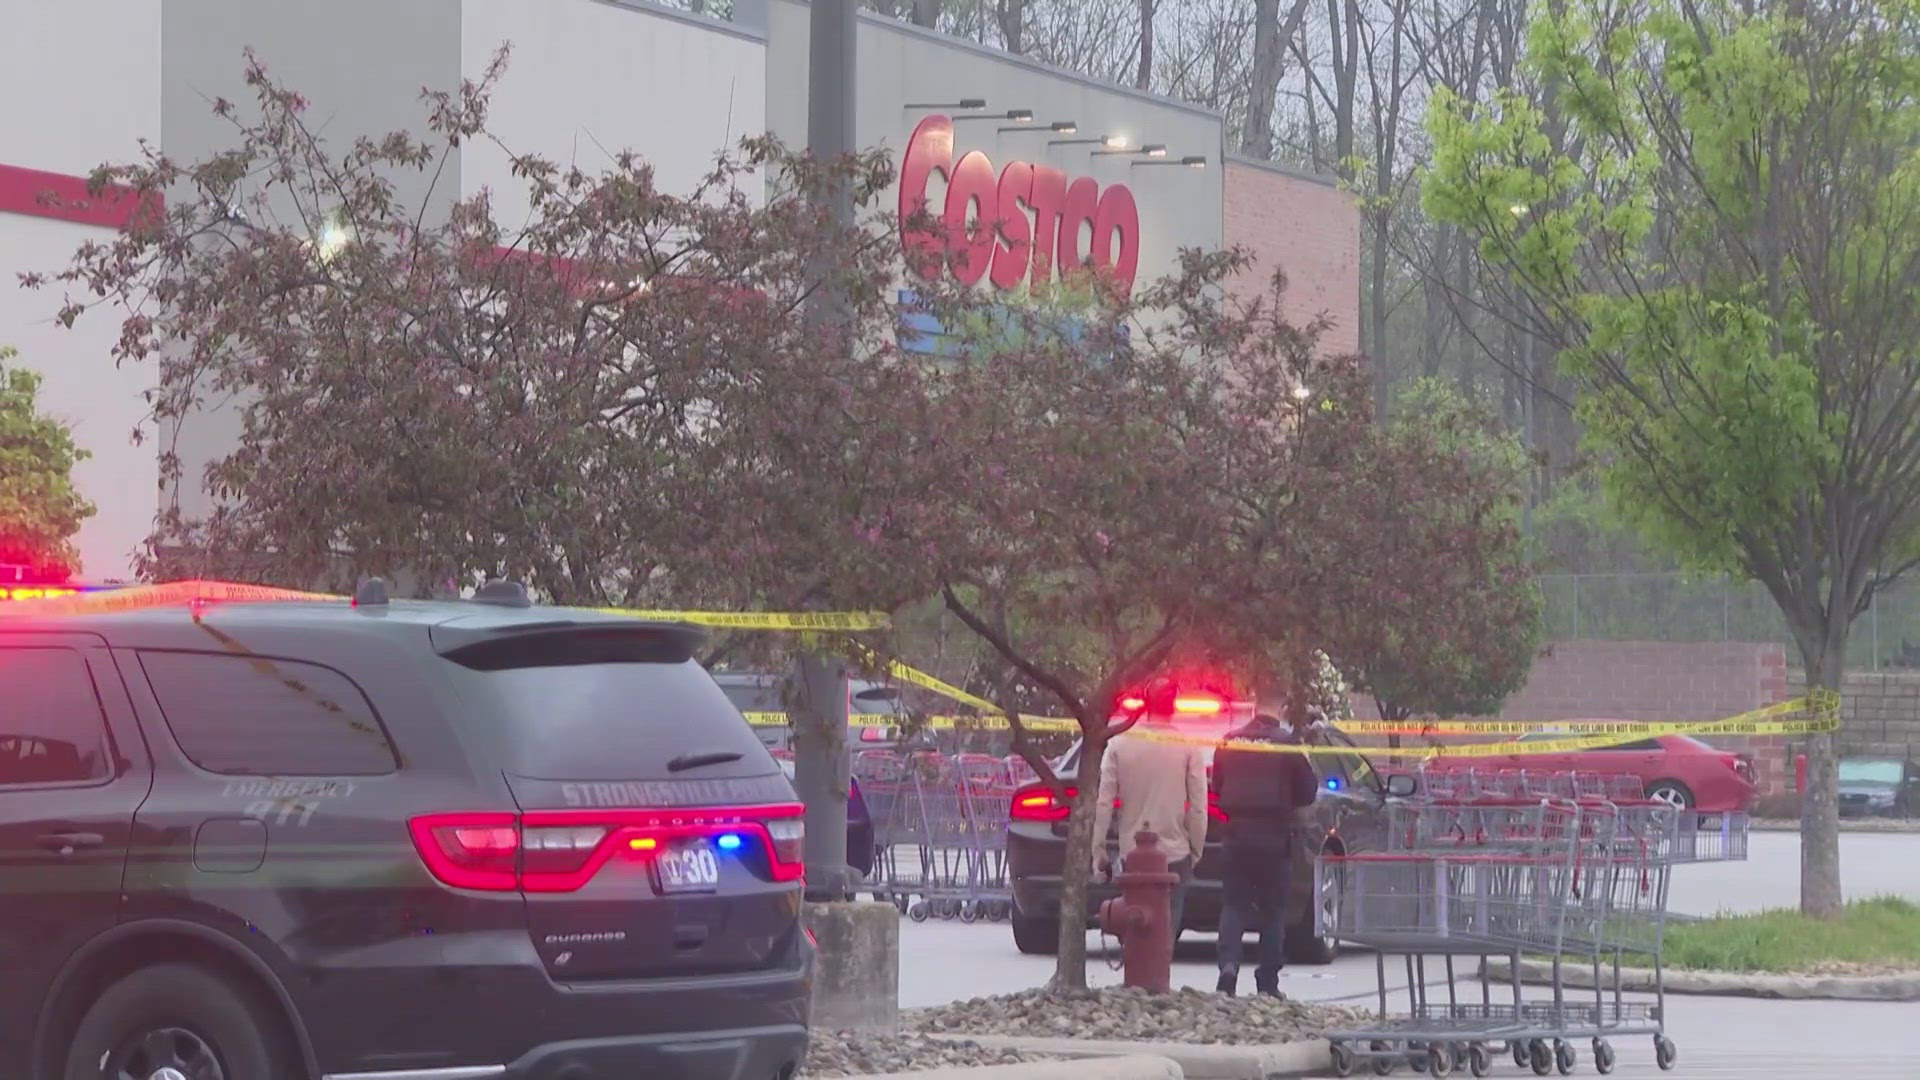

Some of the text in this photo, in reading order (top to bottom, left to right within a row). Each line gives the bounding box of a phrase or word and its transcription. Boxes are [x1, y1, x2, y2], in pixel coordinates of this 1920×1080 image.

[899, 114, 1140, 301] COSTCO
[1361, 722, 1380, 731] POLICE
[1382, 722, 1395, 731] LINE
[1464, 723, 1543, 732] POLICE LINE DO NOT CROSS
[1569, 724, 1649, 733] POLICE LINE DO NOT CROSS
[1723, 724, 1734, 732] NOT
[1736, 724, 1756, 733] CROSS
[1783, 723, 1803, 731] POLICE
[222, 782, 359, 797] EMERGENCY
[562, 781, 727, 806] STRONGSVILLE
[244, 800, 320, 827] 911
[545, 931, 626, 943] DURANGO
